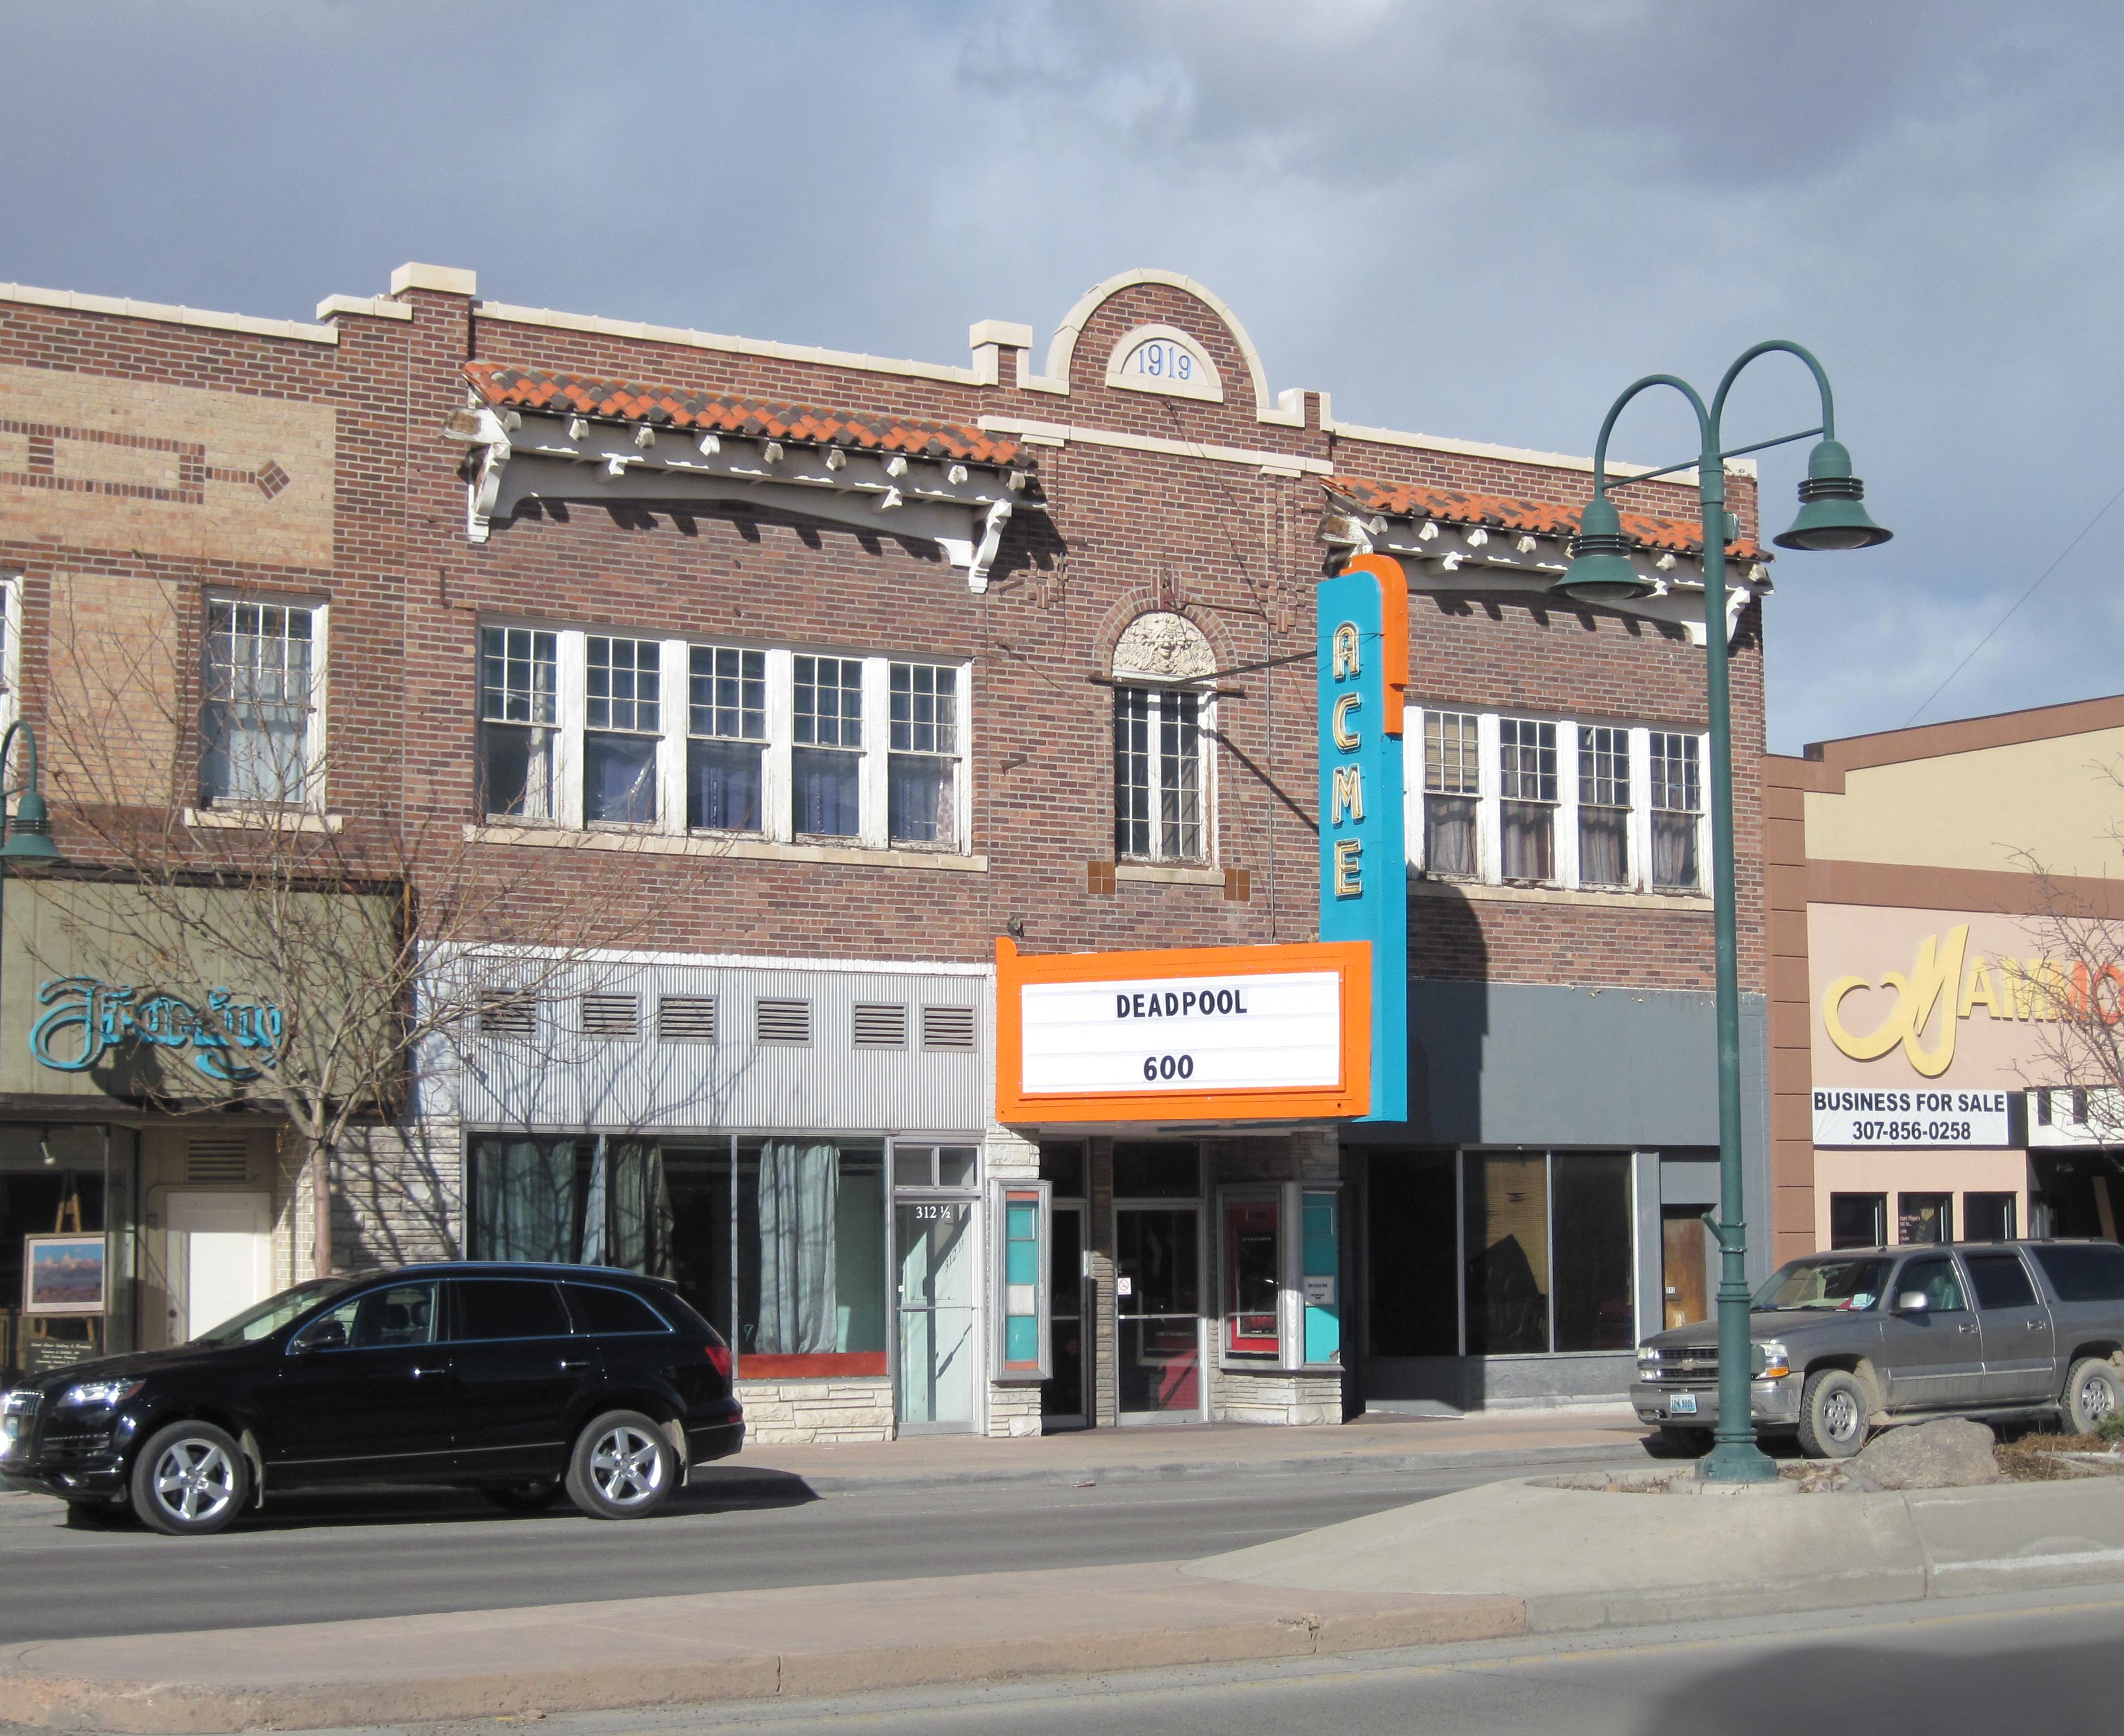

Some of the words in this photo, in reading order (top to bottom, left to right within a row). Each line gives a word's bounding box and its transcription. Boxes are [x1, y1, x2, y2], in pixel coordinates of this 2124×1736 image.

[1139, 344, 1192, 380] 1919
[1332, 622, 1363, 898] ACME
[1116, 989, 1247, 1018] DEADPOOL
[1143, 1054, 1194, 1081] 600
[1814, 1092, 1911, 1112] BUSINESS
[1916, 1093, 1953, 1112] FOR
[1957, 1093, 2005, 1113] SALE
[1852, 1121, 1971, 1140] 307-856-0258
[916, 1206, 937, 1219] 312
